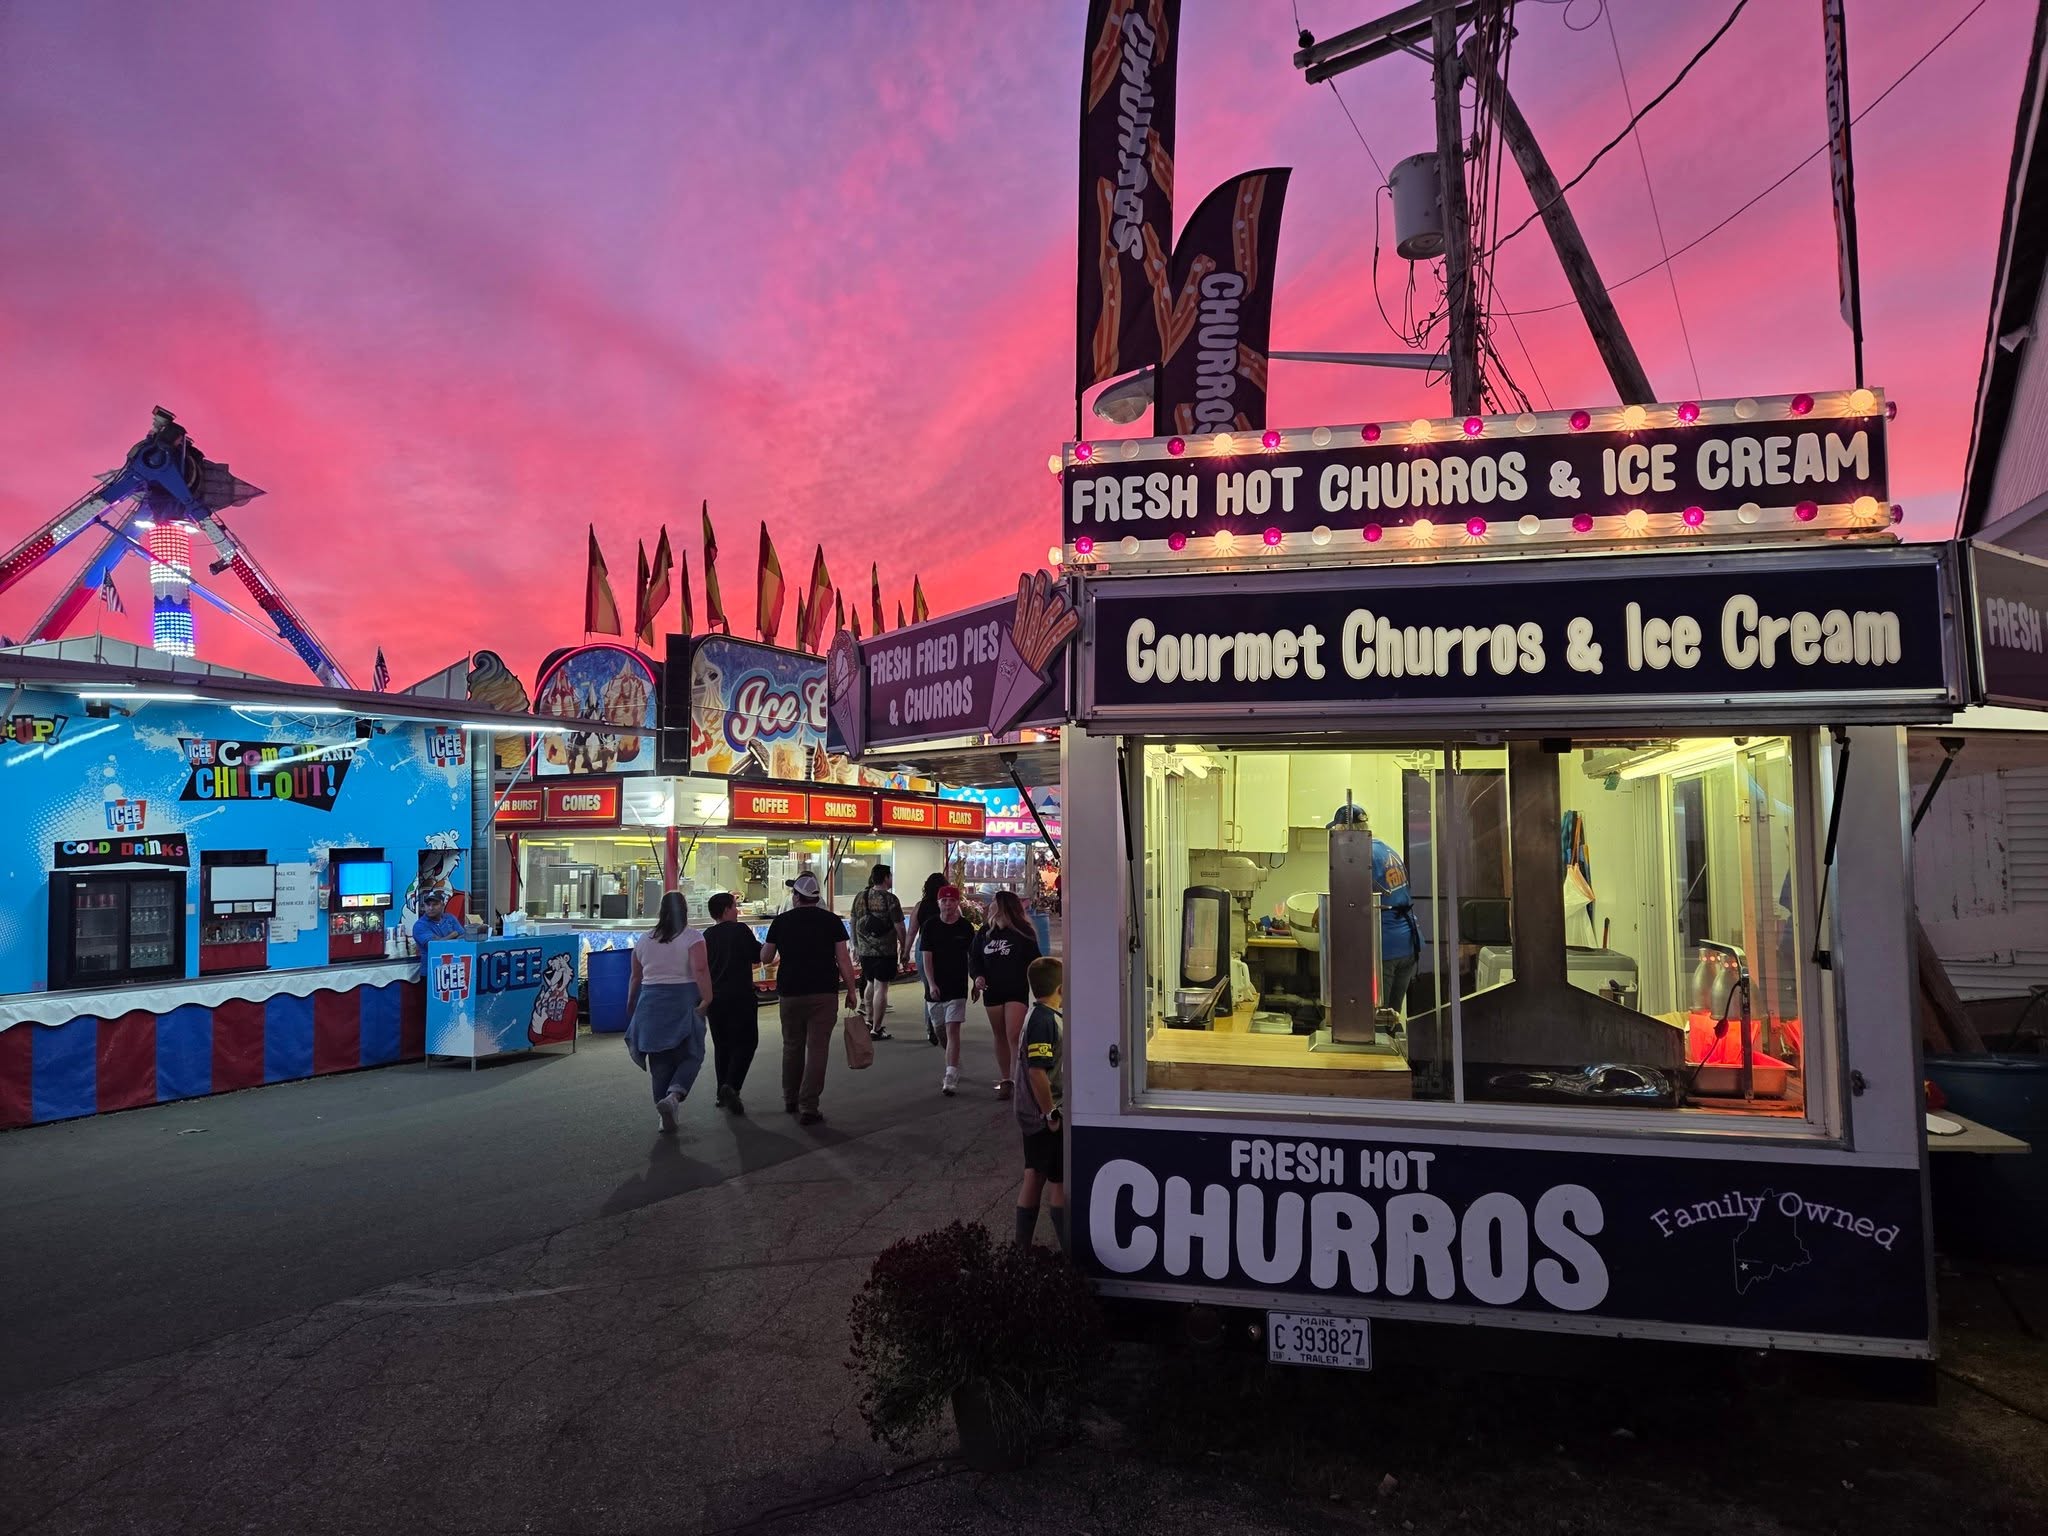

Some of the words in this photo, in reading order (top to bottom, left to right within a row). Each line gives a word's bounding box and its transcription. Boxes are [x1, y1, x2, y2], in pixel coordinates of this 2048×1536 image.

[1072, 473, 1199, 524] FRESH
[1216, 467, 1303, 517] HOT
[1319, 451, 1528, 513] CHURROS
[1549, 460, 1582, 499] &
[1602, 444, 1678, 497] ICE
[1696, 431, 1870, 491] CREAM
[1986, 597, 2043, 654] FRESH
[1126, 617, 1326, 684] Gourmet
[1342, 608, 1546, 681] Churros
[1566, 616, 1603, 675] &
[1625, 601, 1702, 671] Ice
[1721, 594, 1901, 670] Cream
[870, 645, 911, 688] FRESH
[916, 632, 958, 677] FRIED
[963, 620, 999, 666] PIES
[732, 681, 798, 741] Ice
[889, 698, 899, 727] &
[904, 675, 973, 725] CHURROS
[188, 743, 213, 759] ICEE
[321, 747, 356, 763] AND
[430, 734, 464, 759] ICEE
[275, 764, 337, 800] OUT!
[109, 804, 142, 826] ICEE
[512, 799, 538, 811] BURST
[562, 795, 602, 811] CONES
[752, 797, 789, 814] COFFEE
[824, 801, 857, 818] SHAKES
[892, 806, 925, 823] SUNDAES
[948, 810, 972, 825] FLOATS
[988, 821, 1040, 834] APPLES
[990, 940, 1008, 948] NIKE
[1000, 948, 1010, 956] SB
[434, 962, 467, 993] ICEE
[477, 947, 542, 995] ICEE
[1230, 1138, 1344, 1186] FRESH
[1360, 1150, 1436, 1191] HOT
[1650, 1191, 1766, 1238] Family
[1779, 1192, 1900, 1251] Owned
[1089, 1158, 1609, 1312] CHURROS
[1300, 1317, 1336, 1328] MAINE
[1274, 1324, 1286, 1350] C
[1292, 1325, 1364, 1357] 393827
[1300, 1353, 1339, 1365] TRAILER
